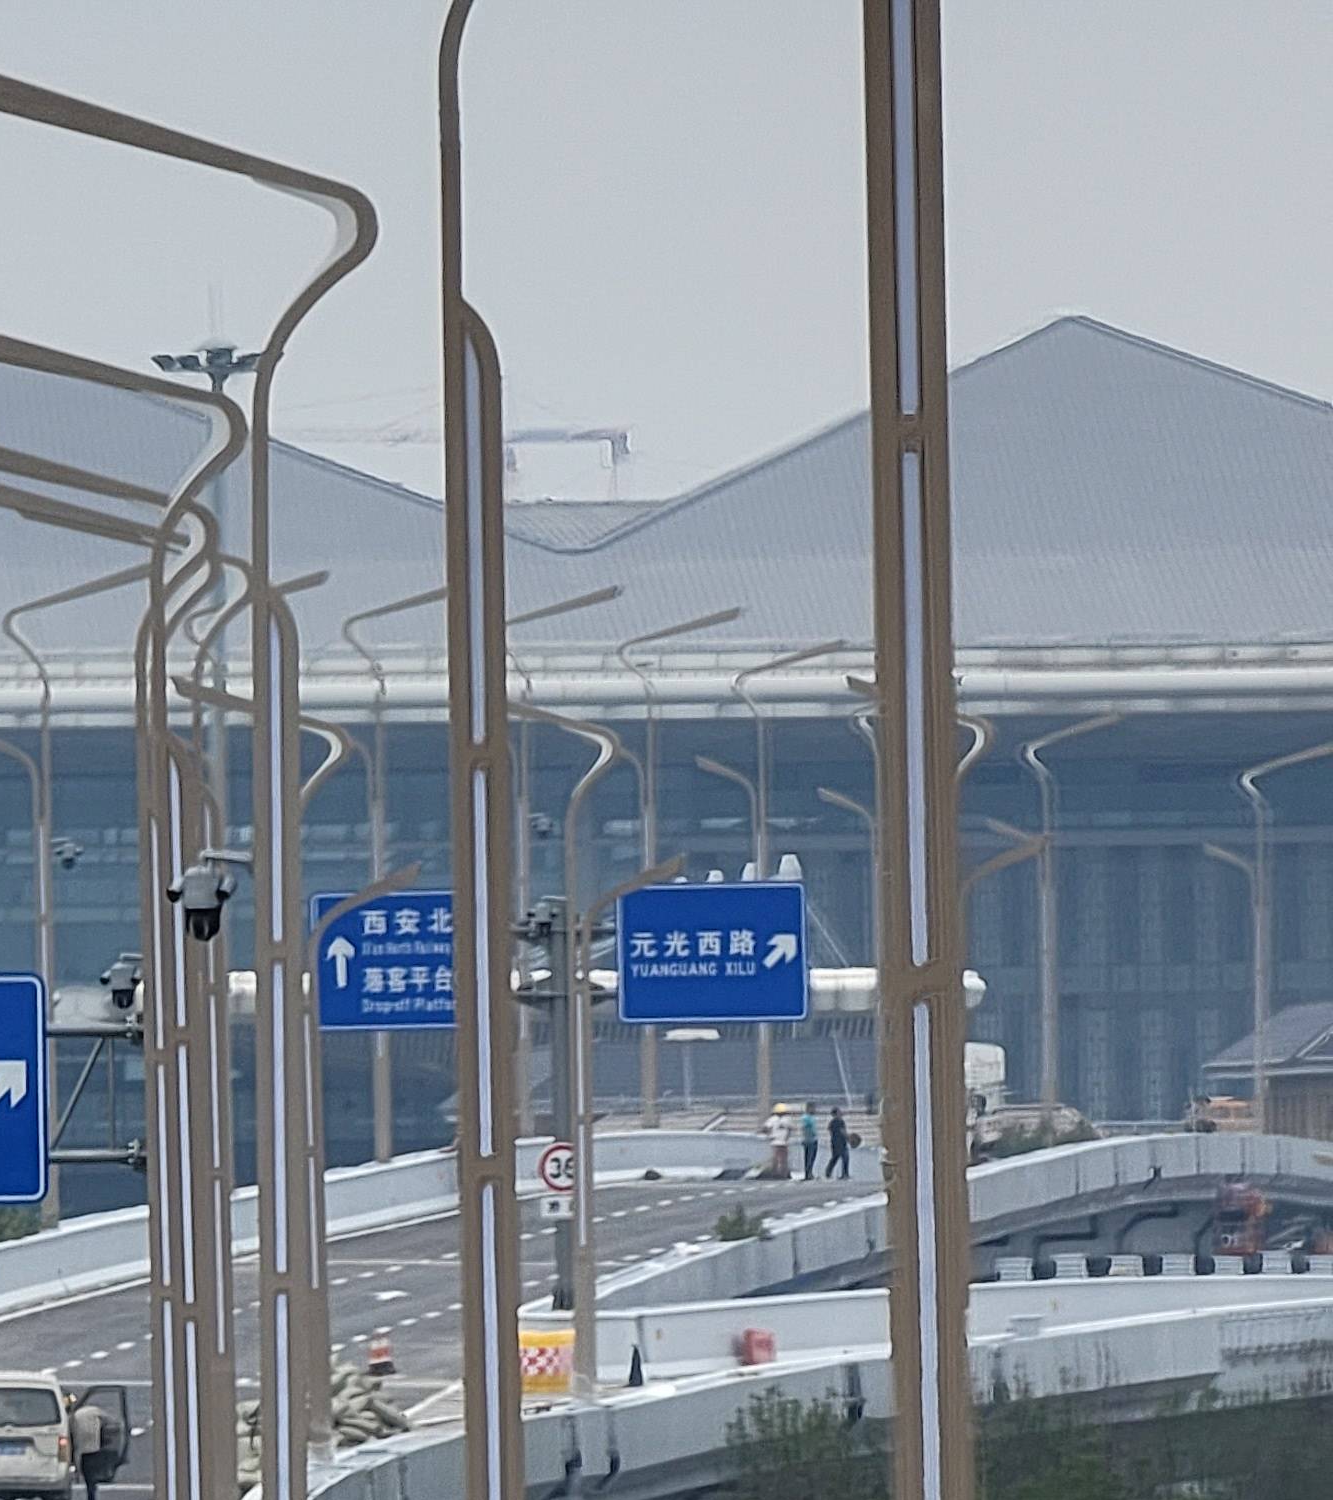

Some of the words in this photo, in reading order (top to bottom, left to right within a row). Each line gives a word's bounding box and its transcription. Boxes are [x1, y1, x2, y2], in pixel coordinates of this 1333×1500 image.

[629, 929, 756, 958] 元光西路
[631, 962, 718, 978] YUANGUANG
[725, 961, 756, 976] XILU
